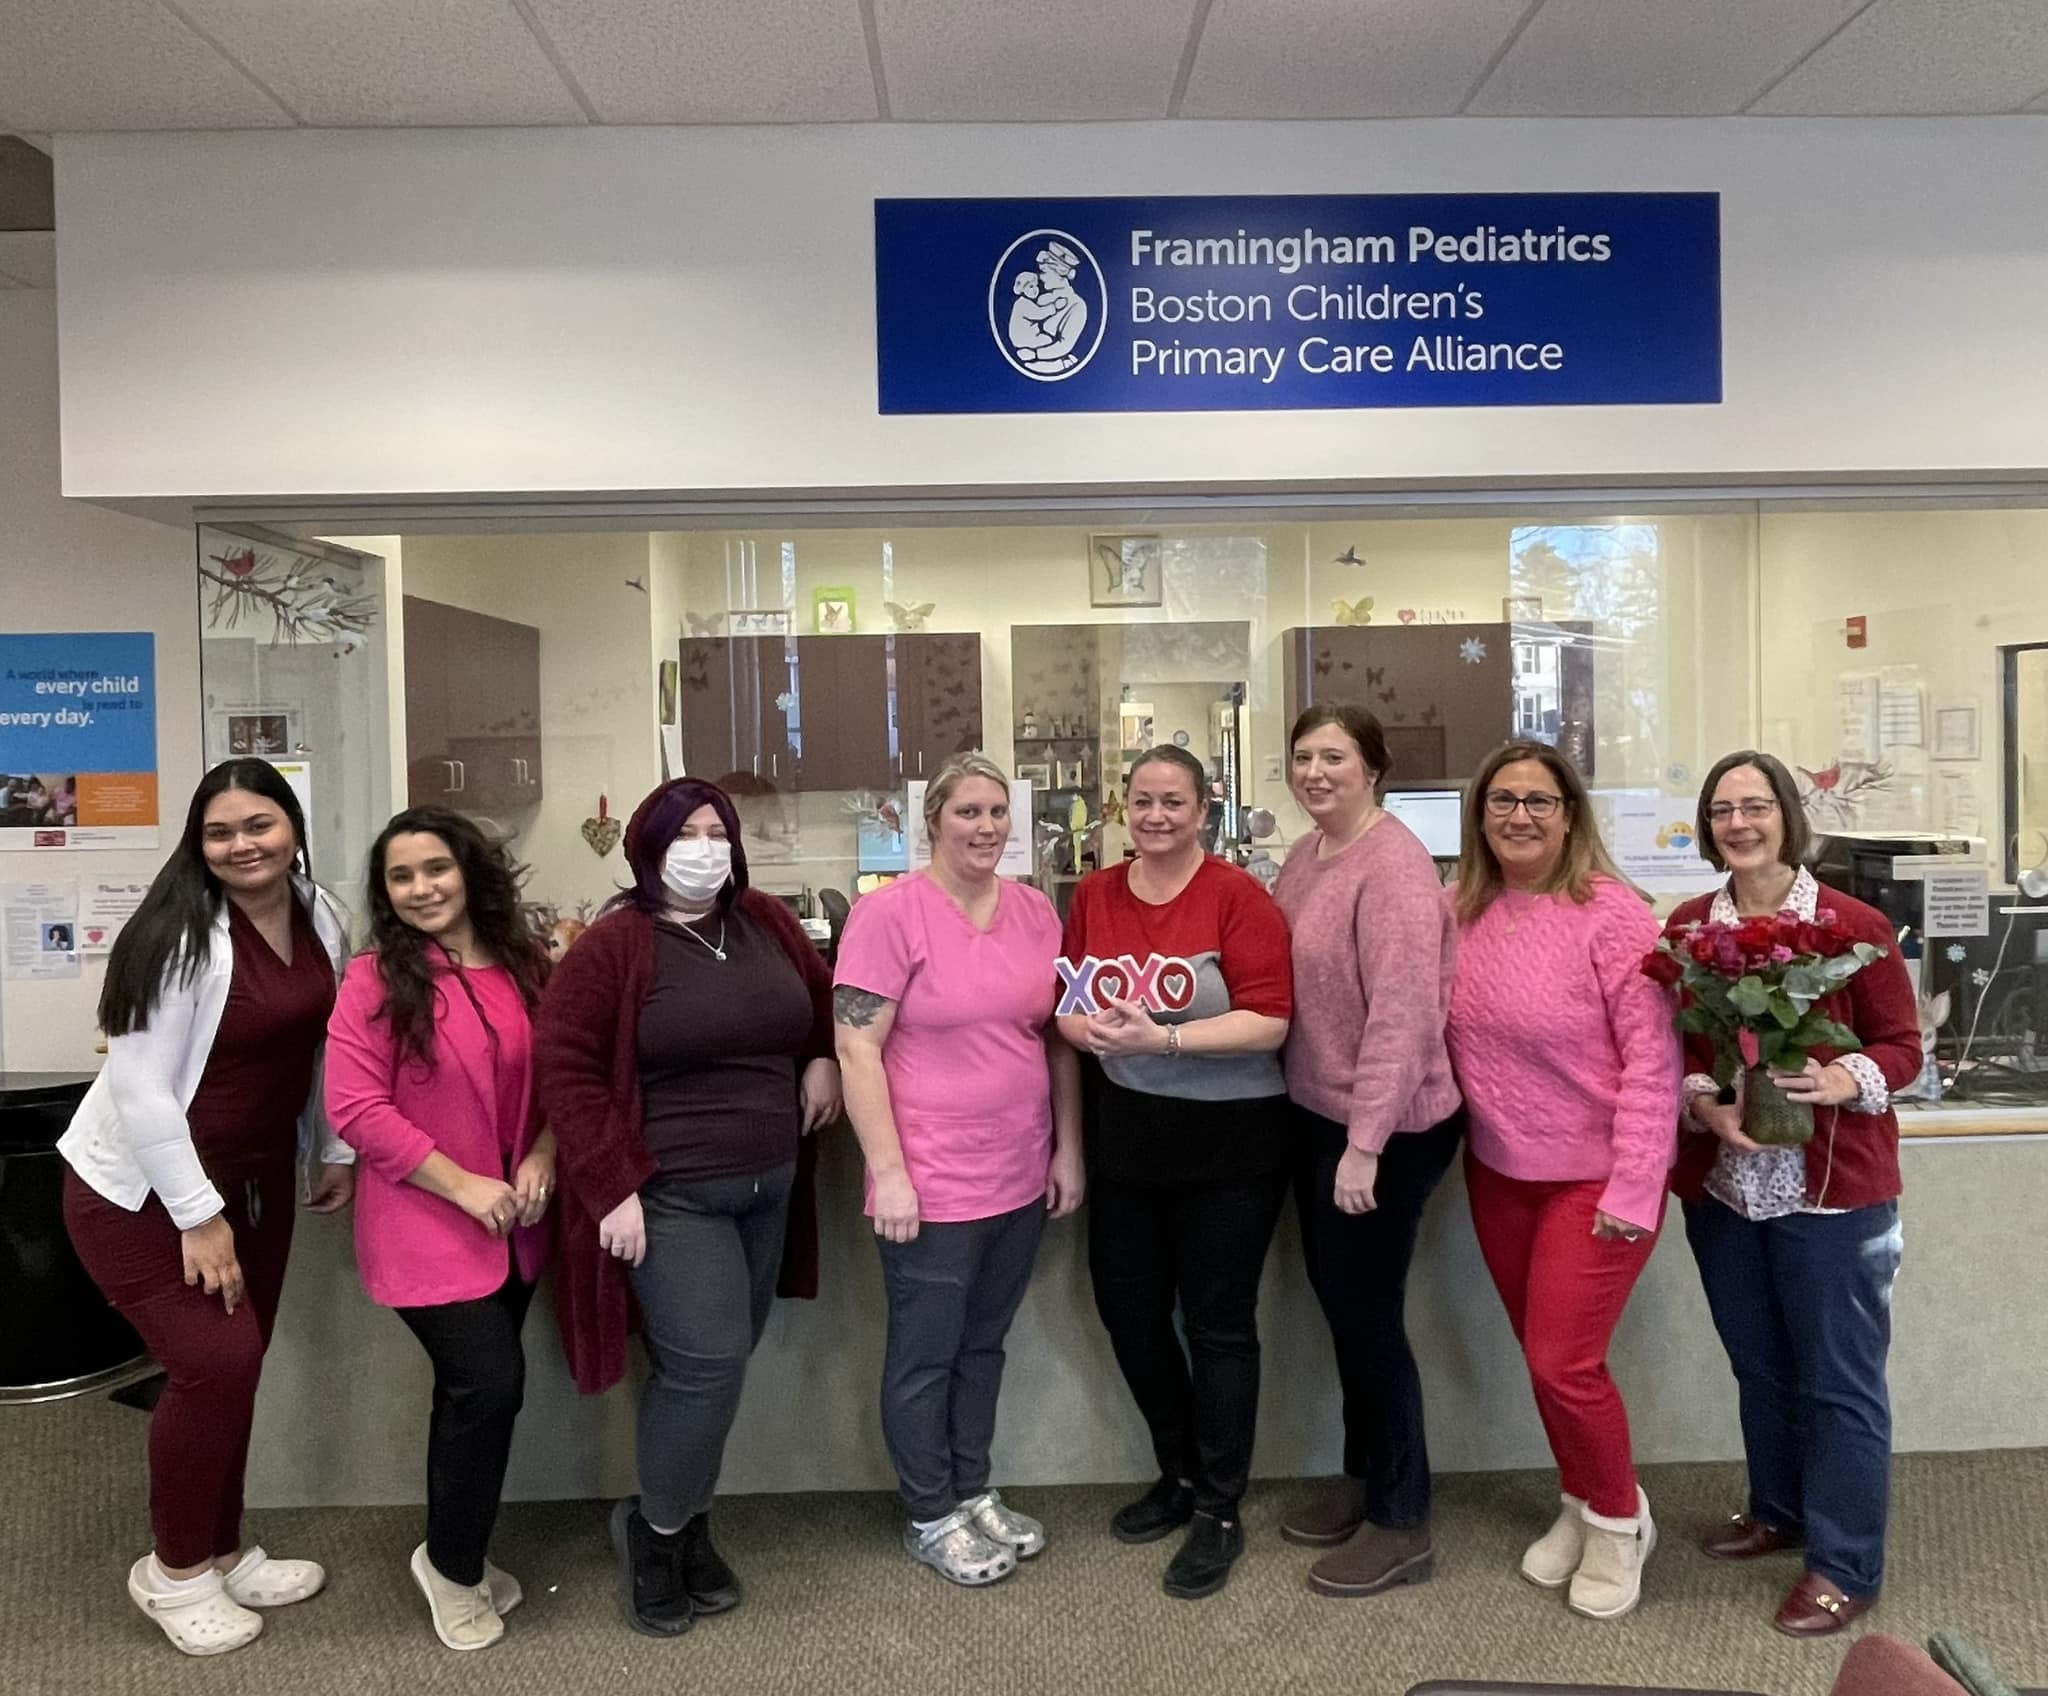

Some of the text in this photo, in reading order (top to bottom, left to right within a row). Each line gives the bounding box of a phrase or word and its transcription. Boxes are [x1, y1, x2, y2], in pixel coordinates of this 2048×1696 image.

[1131, 226, 1611, 271] Framingham Pediatrics
[1132, 283, 1484, 323] Boston Children's
[1132, 335, 1563, 384] Primary Care Alliance
[6, 669, 99, 680] A world where
[35, 676, 139, 697] every child
[0, 708, 95, 728] every day.
[130, 700, 144, 710] to
[1053, 953, 1196, 1015] XOXO
